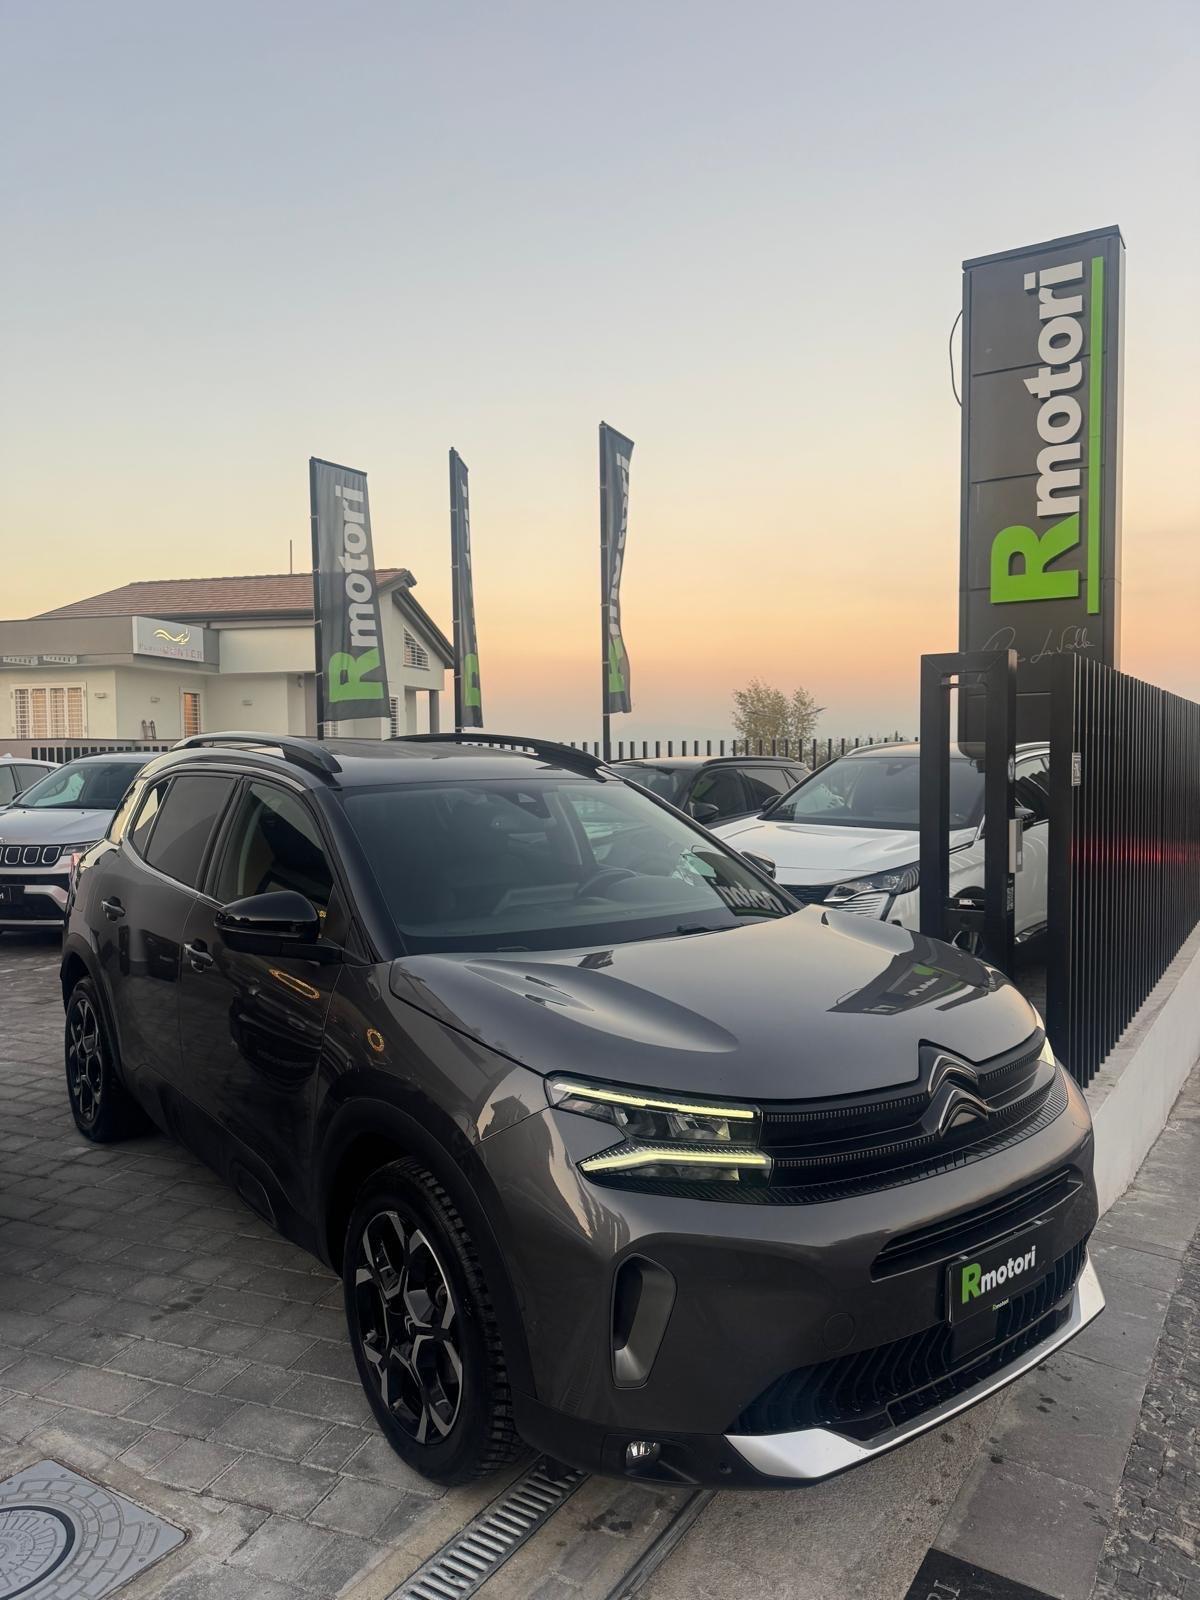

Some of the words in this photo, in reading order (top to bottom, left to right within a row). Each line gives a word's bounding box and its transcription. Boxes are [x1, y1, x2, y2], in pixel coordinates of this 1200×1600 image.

[990, 260, 1083, 604] Rmotori
[328, 485, 385, 703] Rmotori
[961, 1245, 1036, 1304] Rmotori
